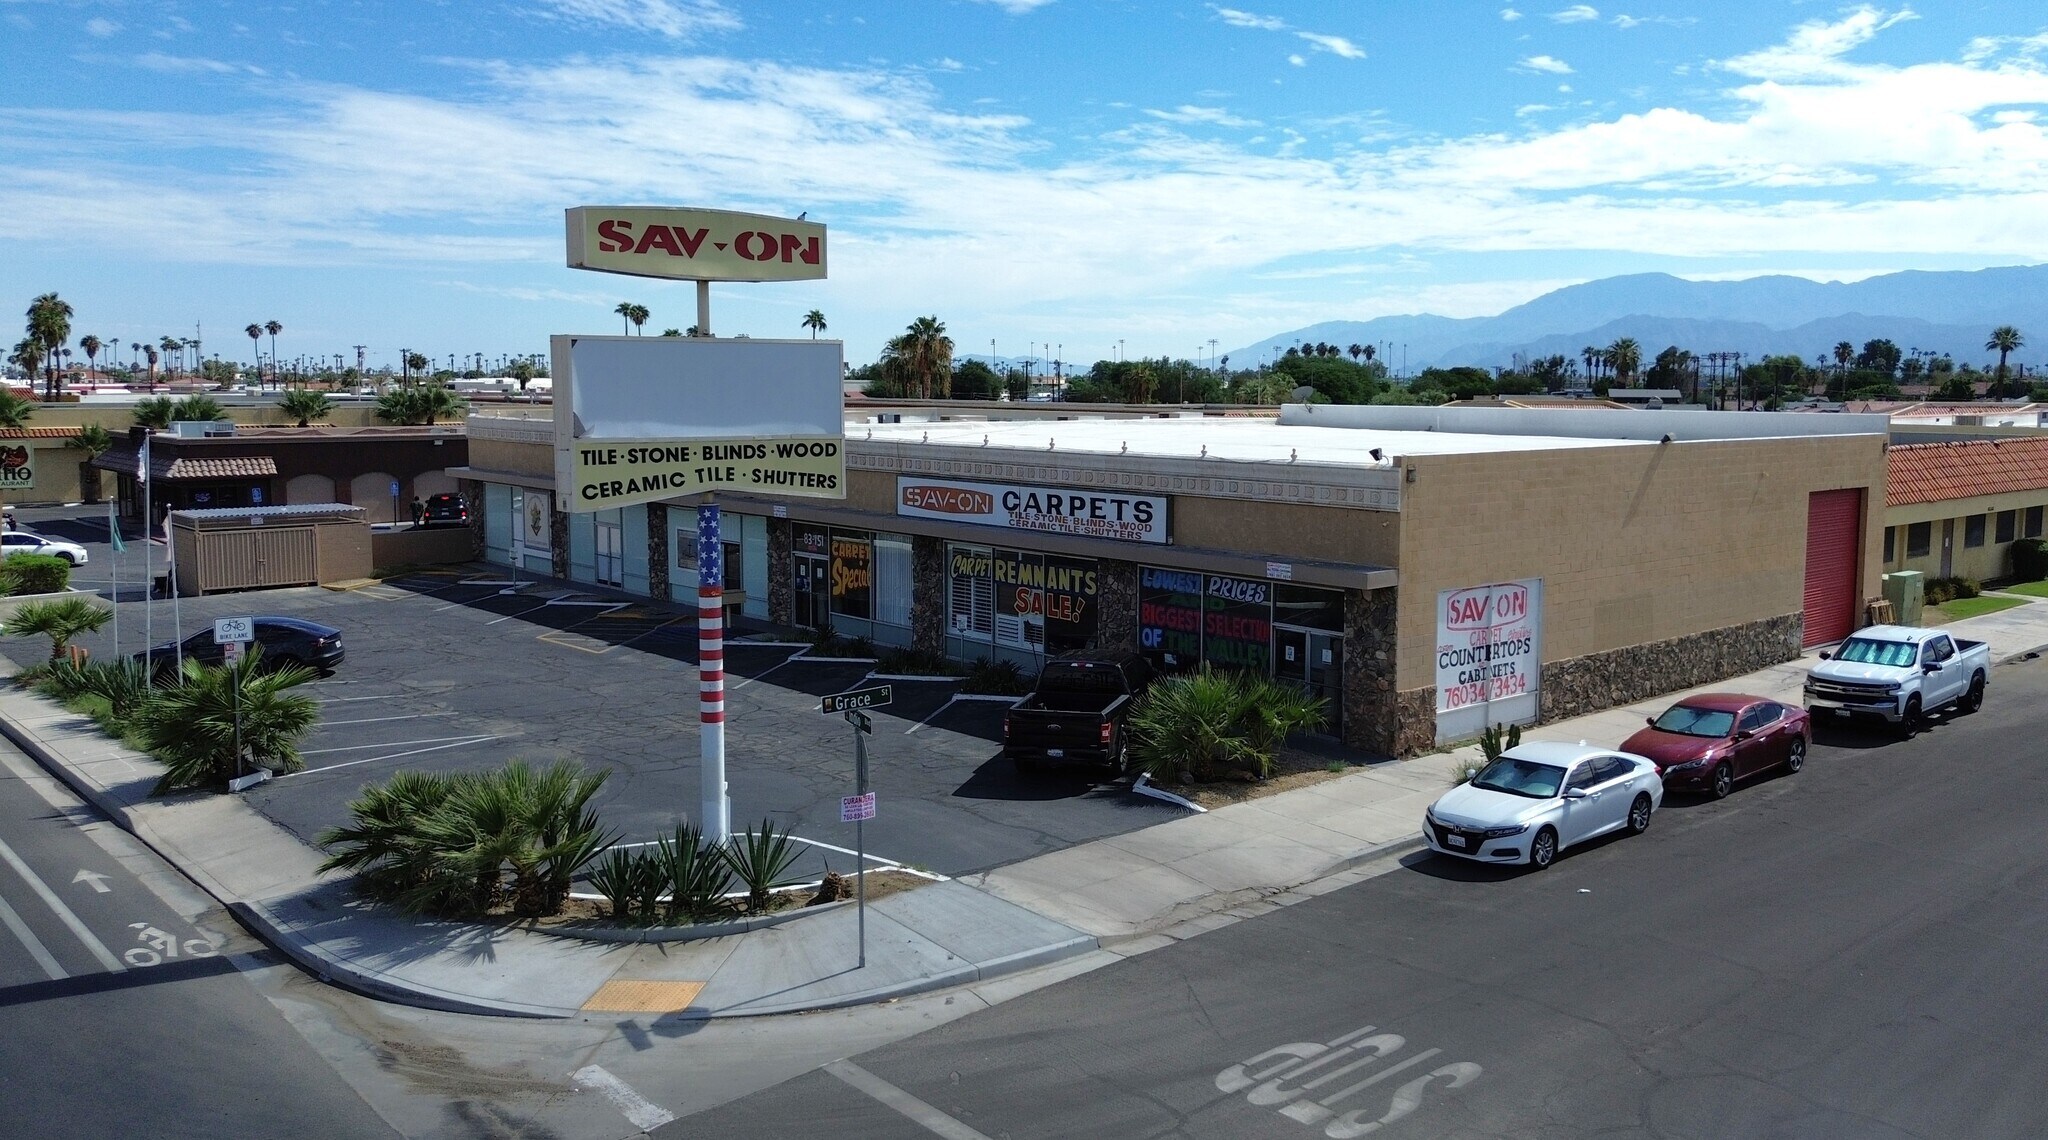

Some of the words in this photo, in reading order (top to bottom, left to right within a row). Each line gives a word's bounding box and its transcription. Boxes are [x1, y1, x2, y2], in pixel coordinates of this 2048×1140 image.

[597, 219, 820, 265] SAV-ON
[581, 449, 617, 466] TILE
[627, 446, 690, 464] STONE
[702, 444, 767, 461] BLINDS
[776, 442, 837, 458] WOOD
[581, 471, 686, 500] CERAMIC
[694, 466, 735, 483] TILE
[751, 468, 837, 489] SHUTTERS
[906, 487, 990, 514] SAV-ON
[1002, 490, 1155, 523] CARPETS
[1008, 510, 1031, 521] TILE
[1033, 512, 1069, 524] STONE
[1073, 516, 1115, 529] BLINDS
[1119, 521, 1153, 533] WOOD
[1084, 526, 1143, 540] SHUTTERS
[994, 558, 1098, 596] REMNANTS
[1141, 567, 1201, 595] LOWEST
[1208, 576, 1267, 604] PRICES
[1013, 587, 1086, 623] SALE!
[1140, 602, 1201, 633] BIGGEST
[1141, 627, 1164, 648] OF
[1439, 638, 1531, 670] COUNTERTOPS
[835, 693, 871, 711] Grace
[881, 688, 889, 697] St
[1215, 1025, 1484, 1139] STOP
